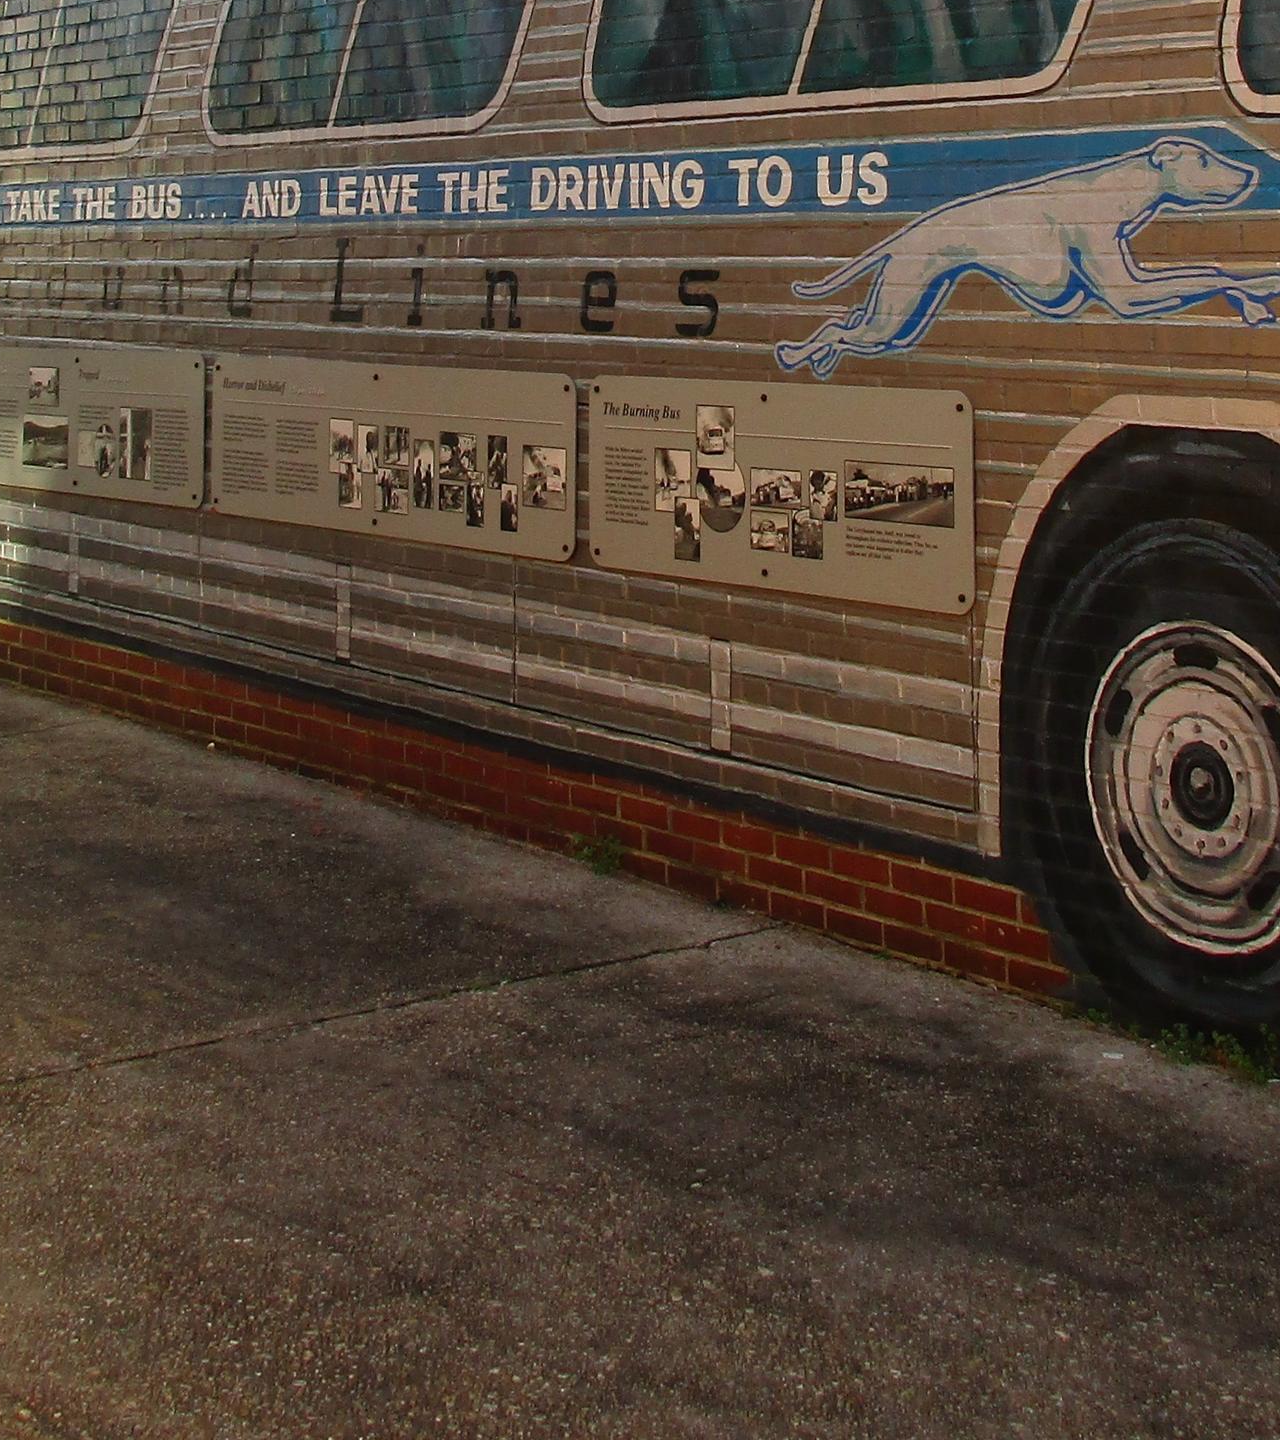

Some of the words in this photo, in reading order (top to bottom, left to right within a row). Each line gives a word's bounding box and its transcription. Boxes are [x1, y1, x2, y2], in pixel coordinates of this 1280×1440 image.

[5, 189, 60, 224] TAKE
[72, 186, 116, 220] THE
[241, 179, 303, 219] AND
[319, 173, 420, 216] LEAVE
[437, 169, 510, 213] THE
[529, 159, 706, 212] DRIVING
[728, 154, 793, 208] TO
[815, 151, 890, 206] US
[603, 401, 621, 418] The
[622, 403, 660, 422] Burning
[662, 405, 681, 421] Bus
